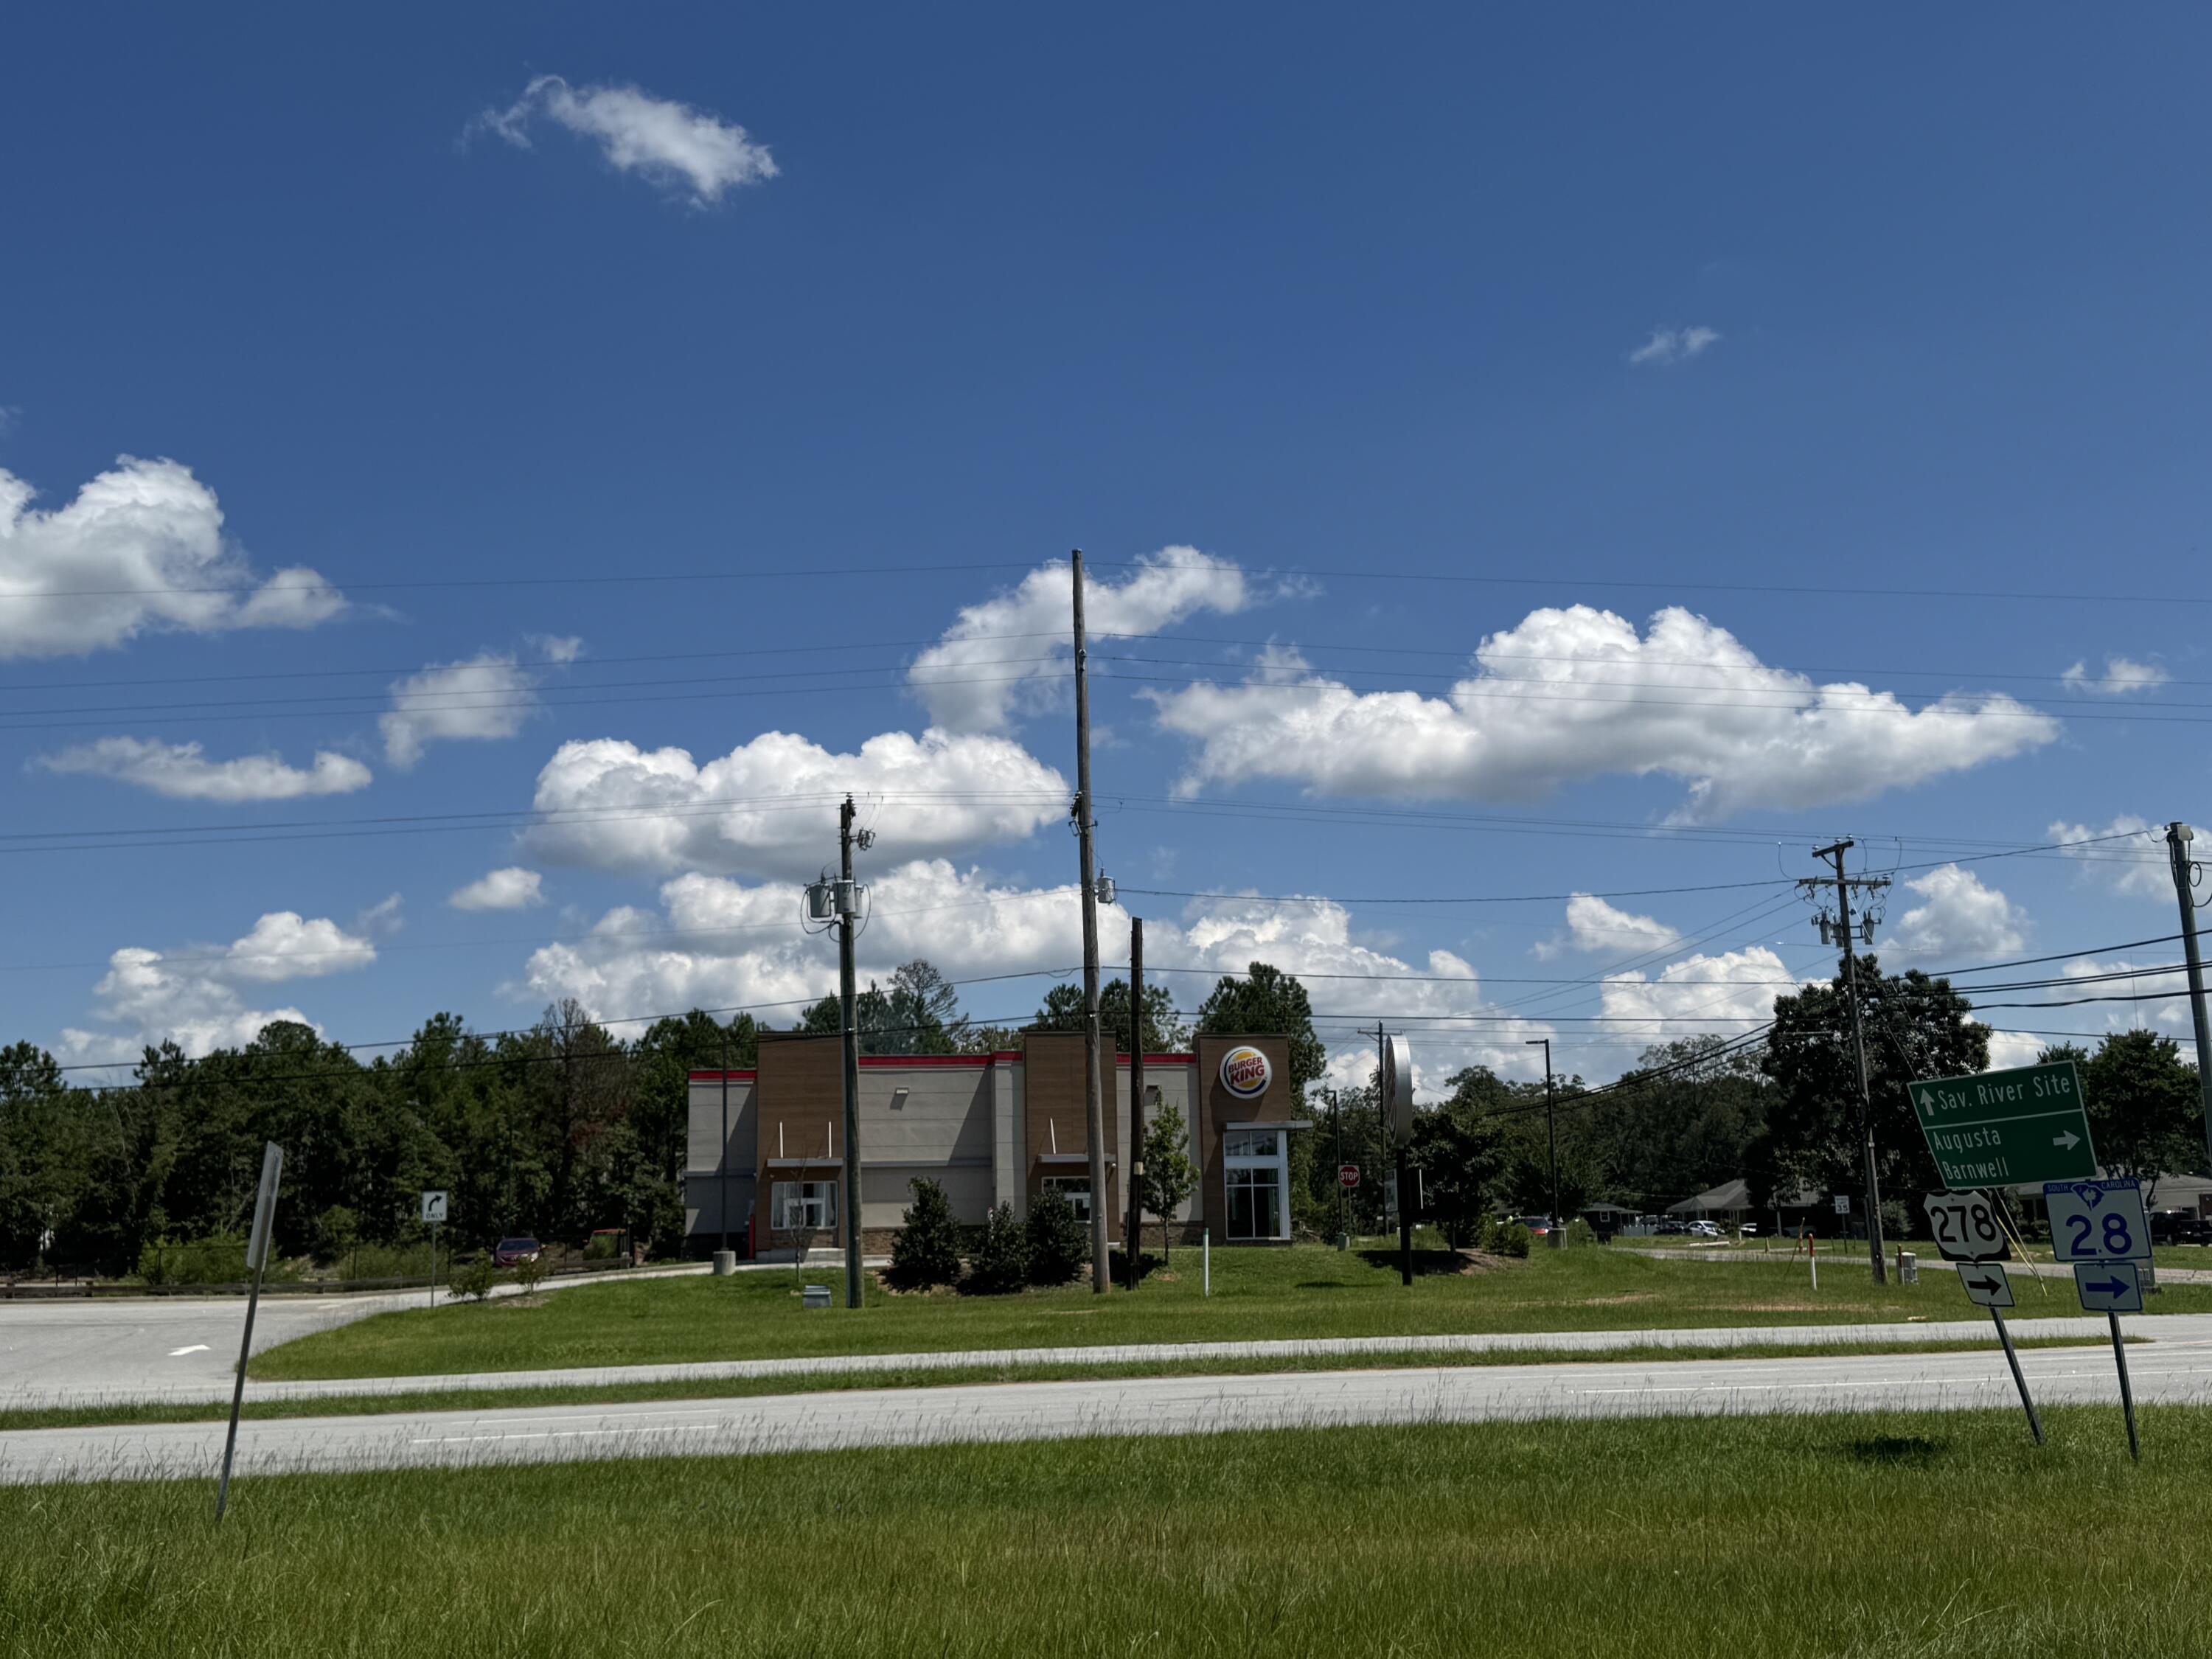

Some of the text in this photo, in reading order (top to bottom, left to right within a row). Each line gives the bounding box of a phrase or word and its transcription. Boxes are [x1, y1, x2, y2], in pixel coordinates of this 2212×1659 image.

[1228, 1057, 1263, 1074] BURGER
[1230, 1065, 1265, 1086] KING
[1938, 1074, 2071, 1110] Sav. River Site
[1932, 1126, 2002, 1154] Augusta
[1340, 1171, 1358, 1180] STOP
[1941, 1156, 2010, 1180] Barnwell
[2046, 1180, 2136, 1193] SOUTH CAROLINA
[1930, 1203, 1997, 1243] 278
[2065, 1212, 2133, 1256] 28
